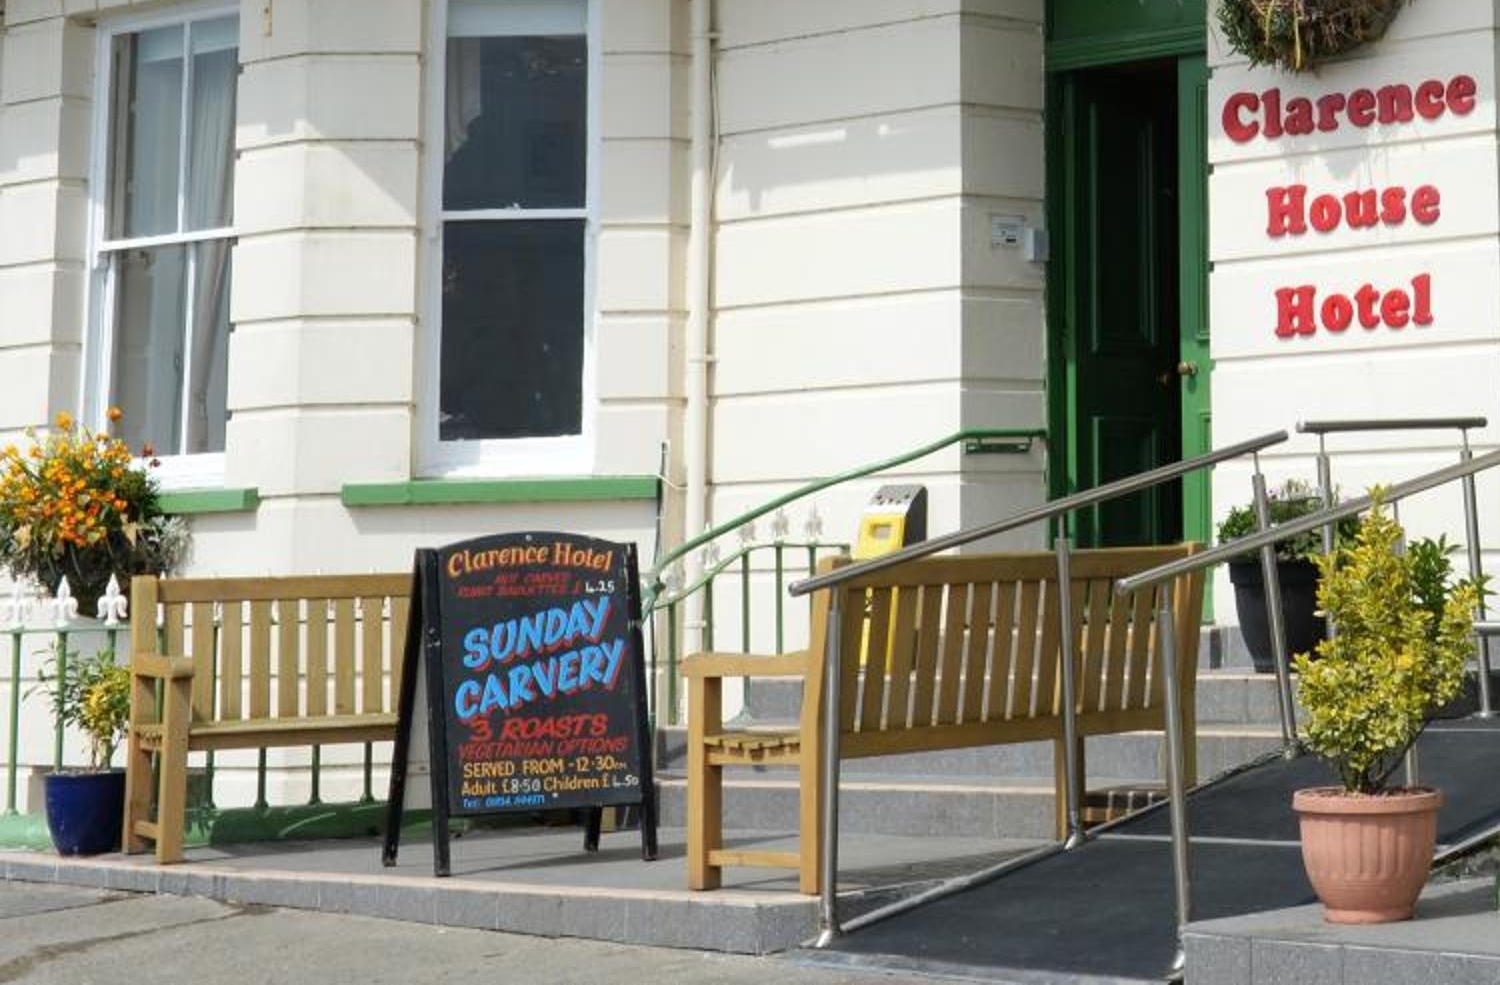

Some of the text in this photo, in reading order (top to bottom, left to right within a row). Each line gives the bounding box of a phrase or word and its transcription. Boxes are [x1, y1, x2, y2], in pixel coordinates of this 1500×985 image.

[1222, 75, 1477, 143] Clarence
[1266, 184, 1441, 237] House
[1275, 273, 1434, 338] Hotel
[447, 545, 548, 578] Clarence
[551, 542, 613, 571] Hotel
[463, 596, 612, 670] SUNDAY
[455, 638, 625, 719] CARVERY
[470, 713, 609, 742] 3 ROASTS
[559, 736, 628, 755] OPTIONS
[462, 781, 497, 796] Adult
[543, 775, 602, 791] Children
[463, 762, 515, 778] SERVED
[523, 758, 564, 775] FROM
